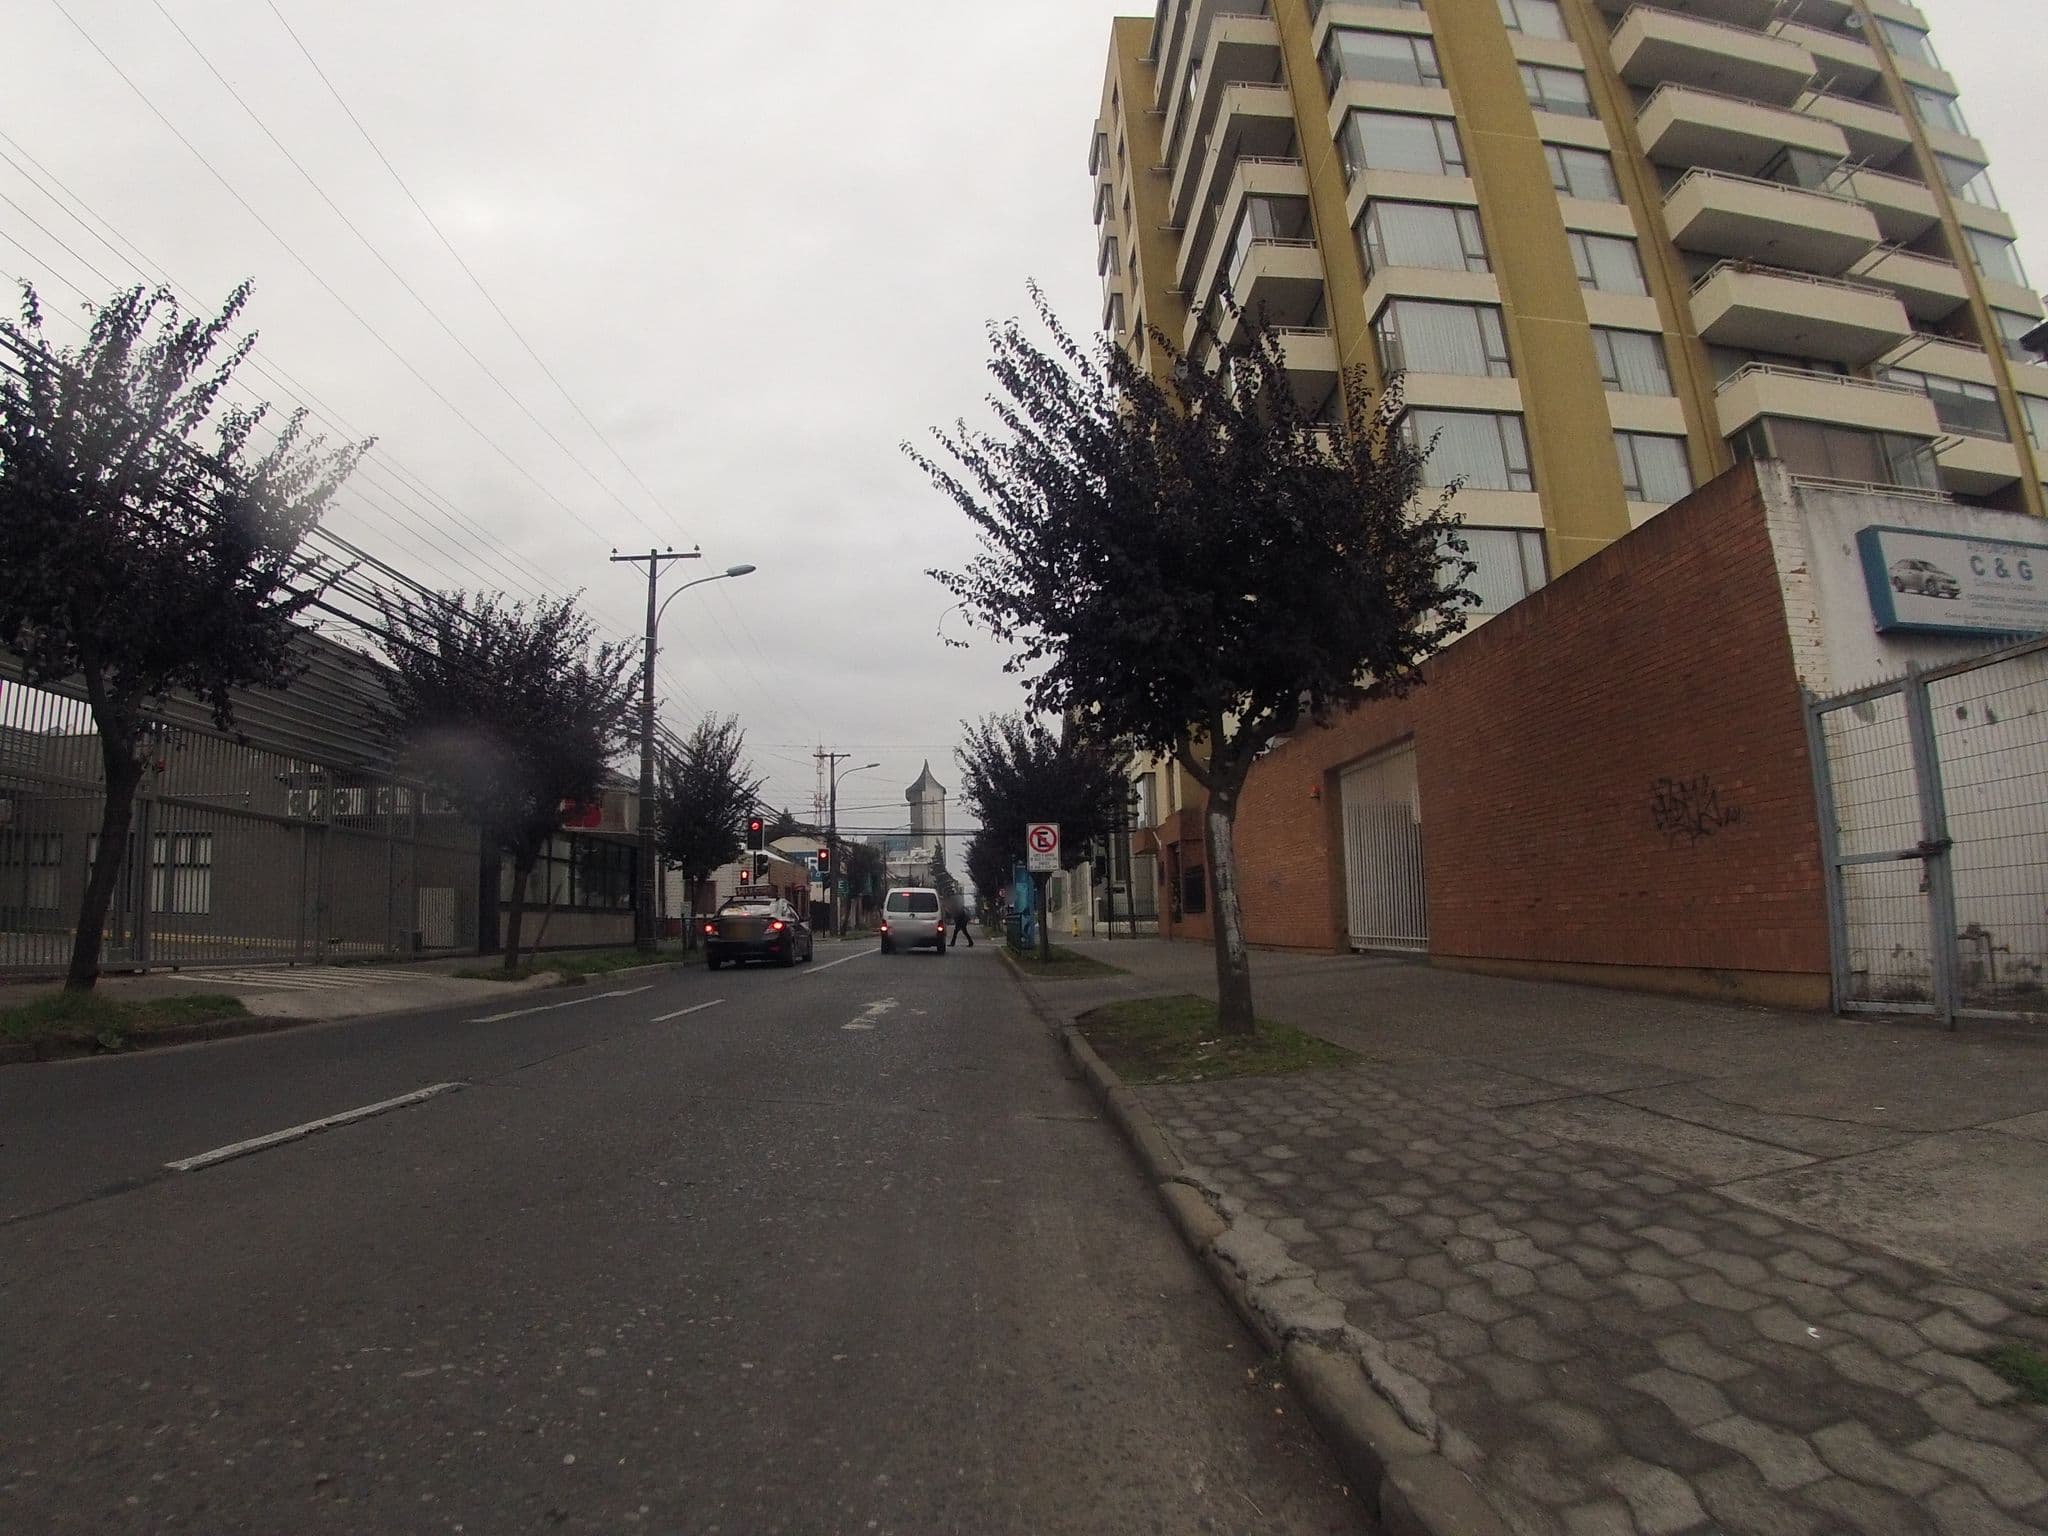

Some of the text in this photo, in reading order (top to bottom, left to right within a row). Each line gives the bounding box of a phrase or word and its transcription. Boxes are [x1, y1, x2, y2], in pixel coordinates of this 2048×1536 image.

[1970, 555, 2033, 581] C & G
